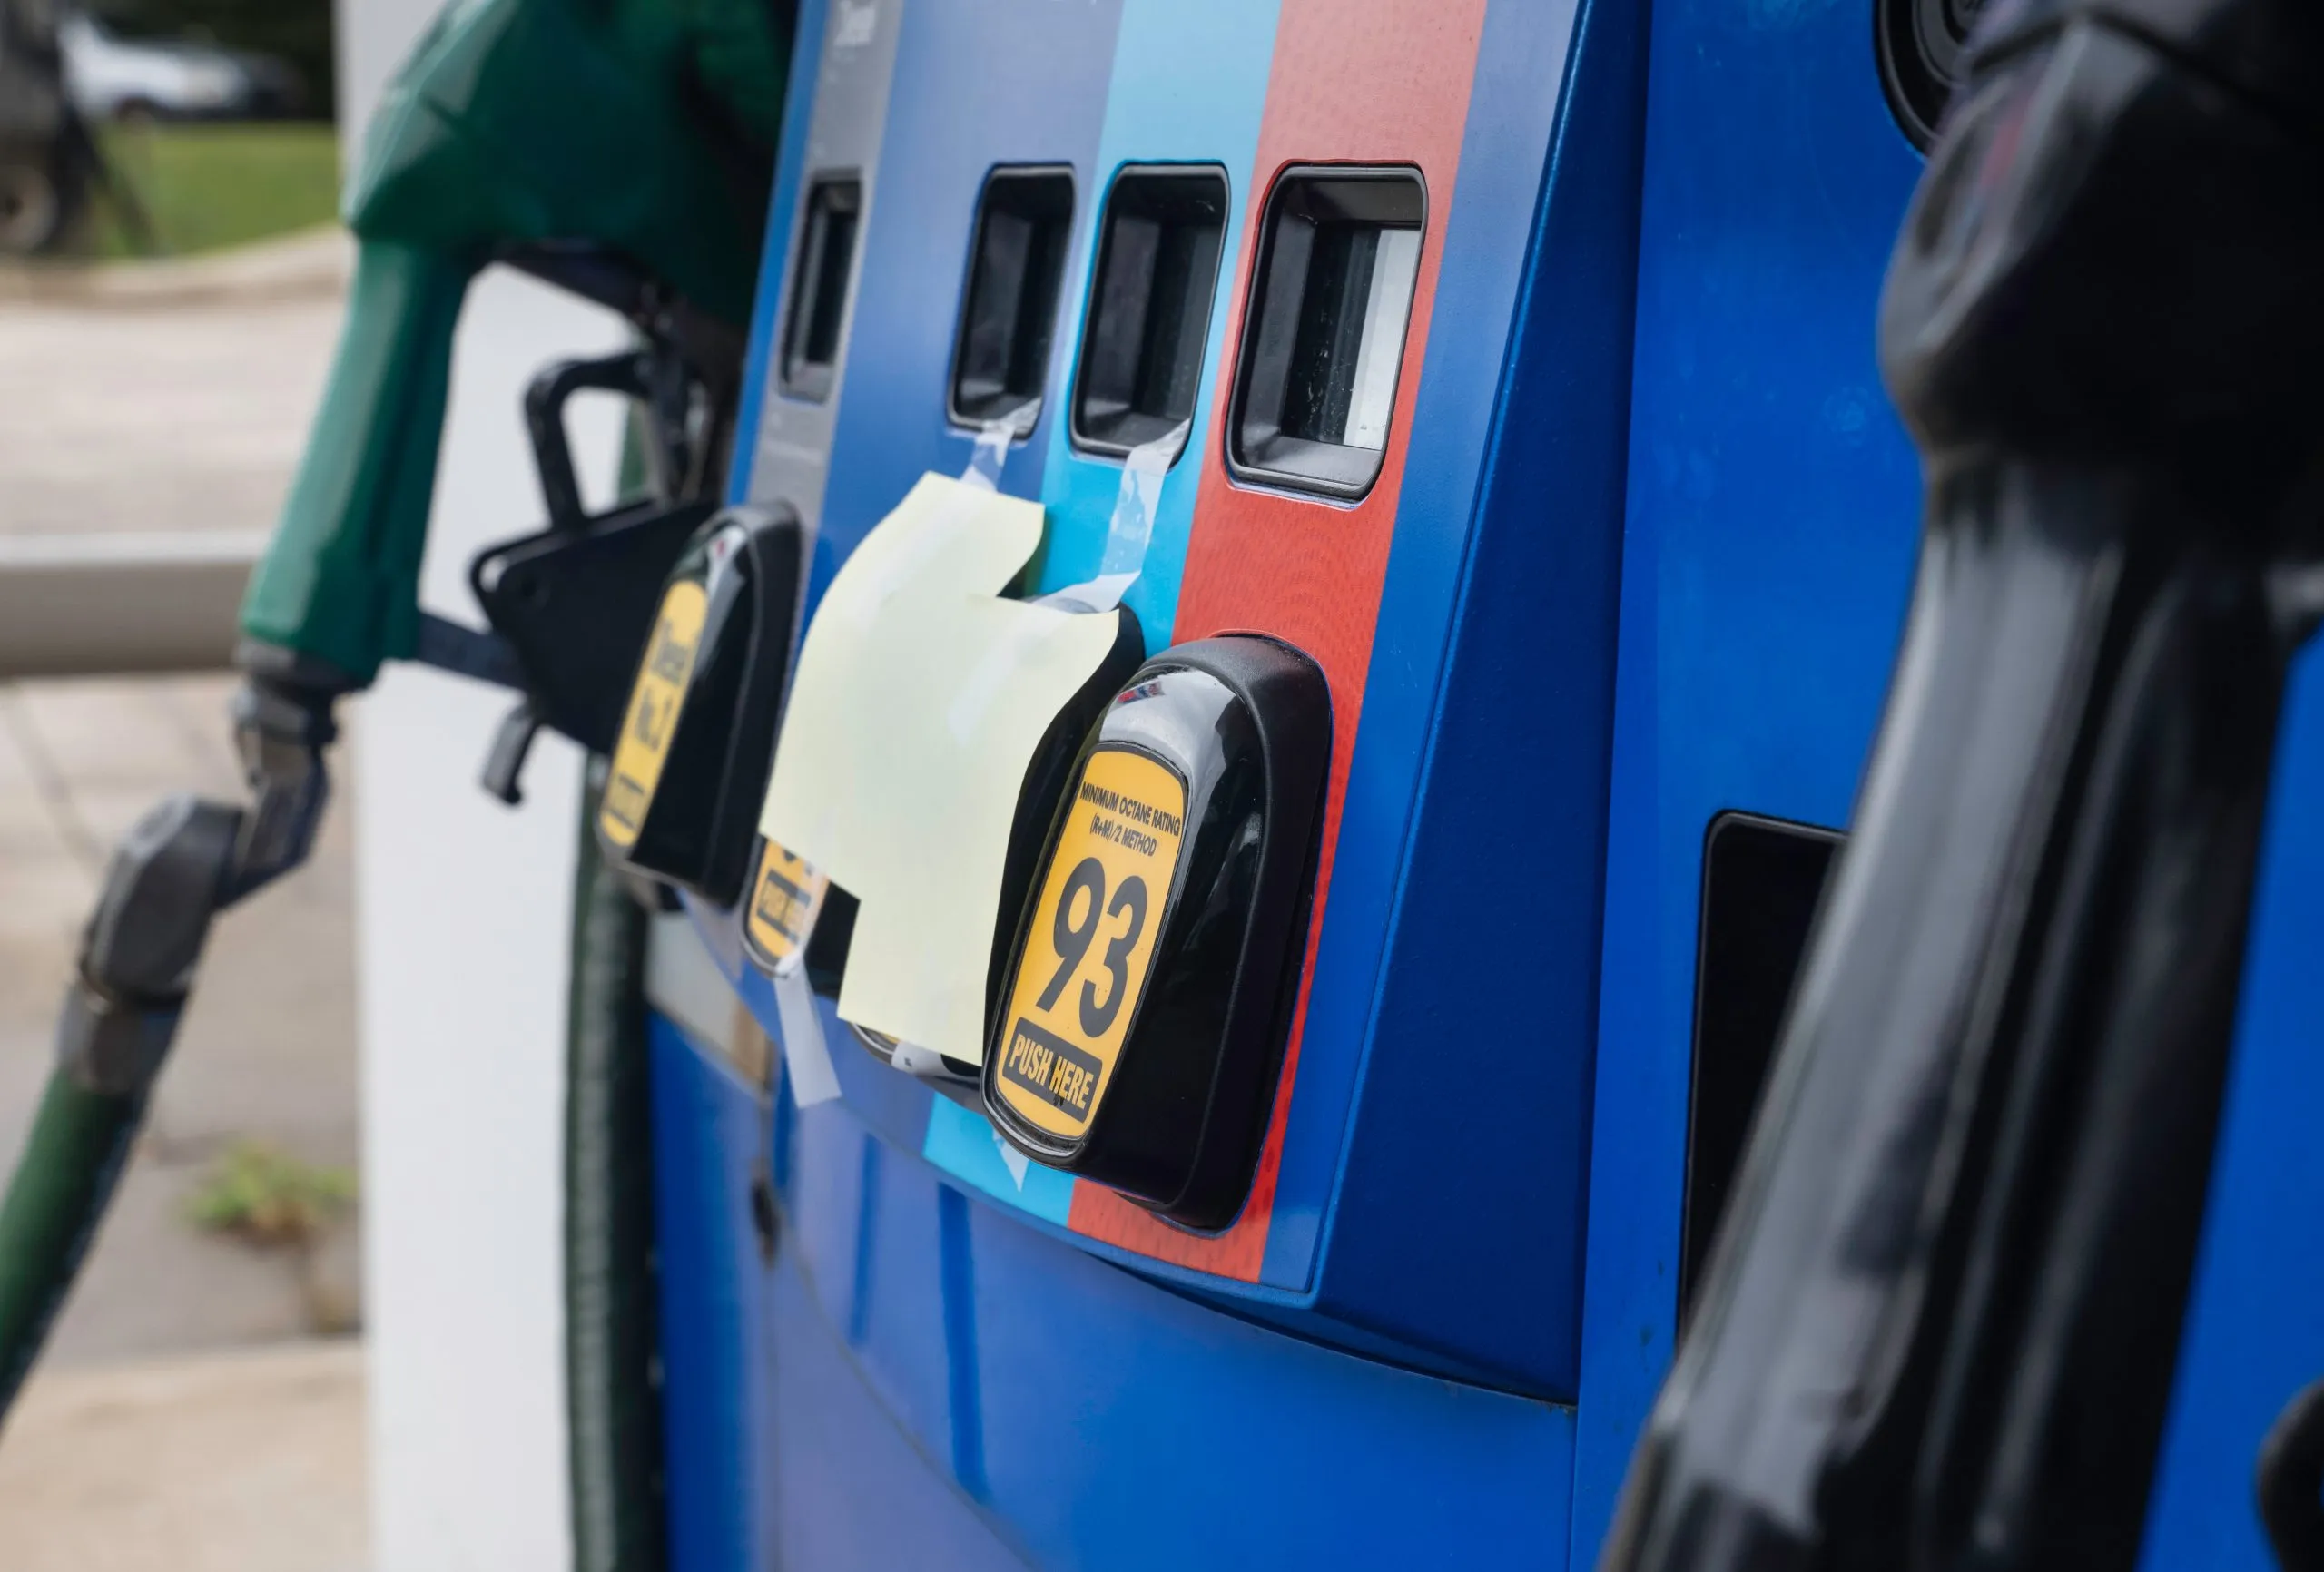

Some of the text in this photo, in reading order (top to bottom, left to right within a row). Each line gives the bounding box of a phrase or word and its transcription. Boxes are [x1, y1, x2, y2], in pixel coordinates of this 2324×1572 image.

[1080, 781, 1180, 837] MINIMUM OCTANE RATING
[1121, 827, 1157, 857] METHOD
[1036, 857, 1147, 1038] 93
[1009, 1033, 1094, 1110] PUSH HERE
